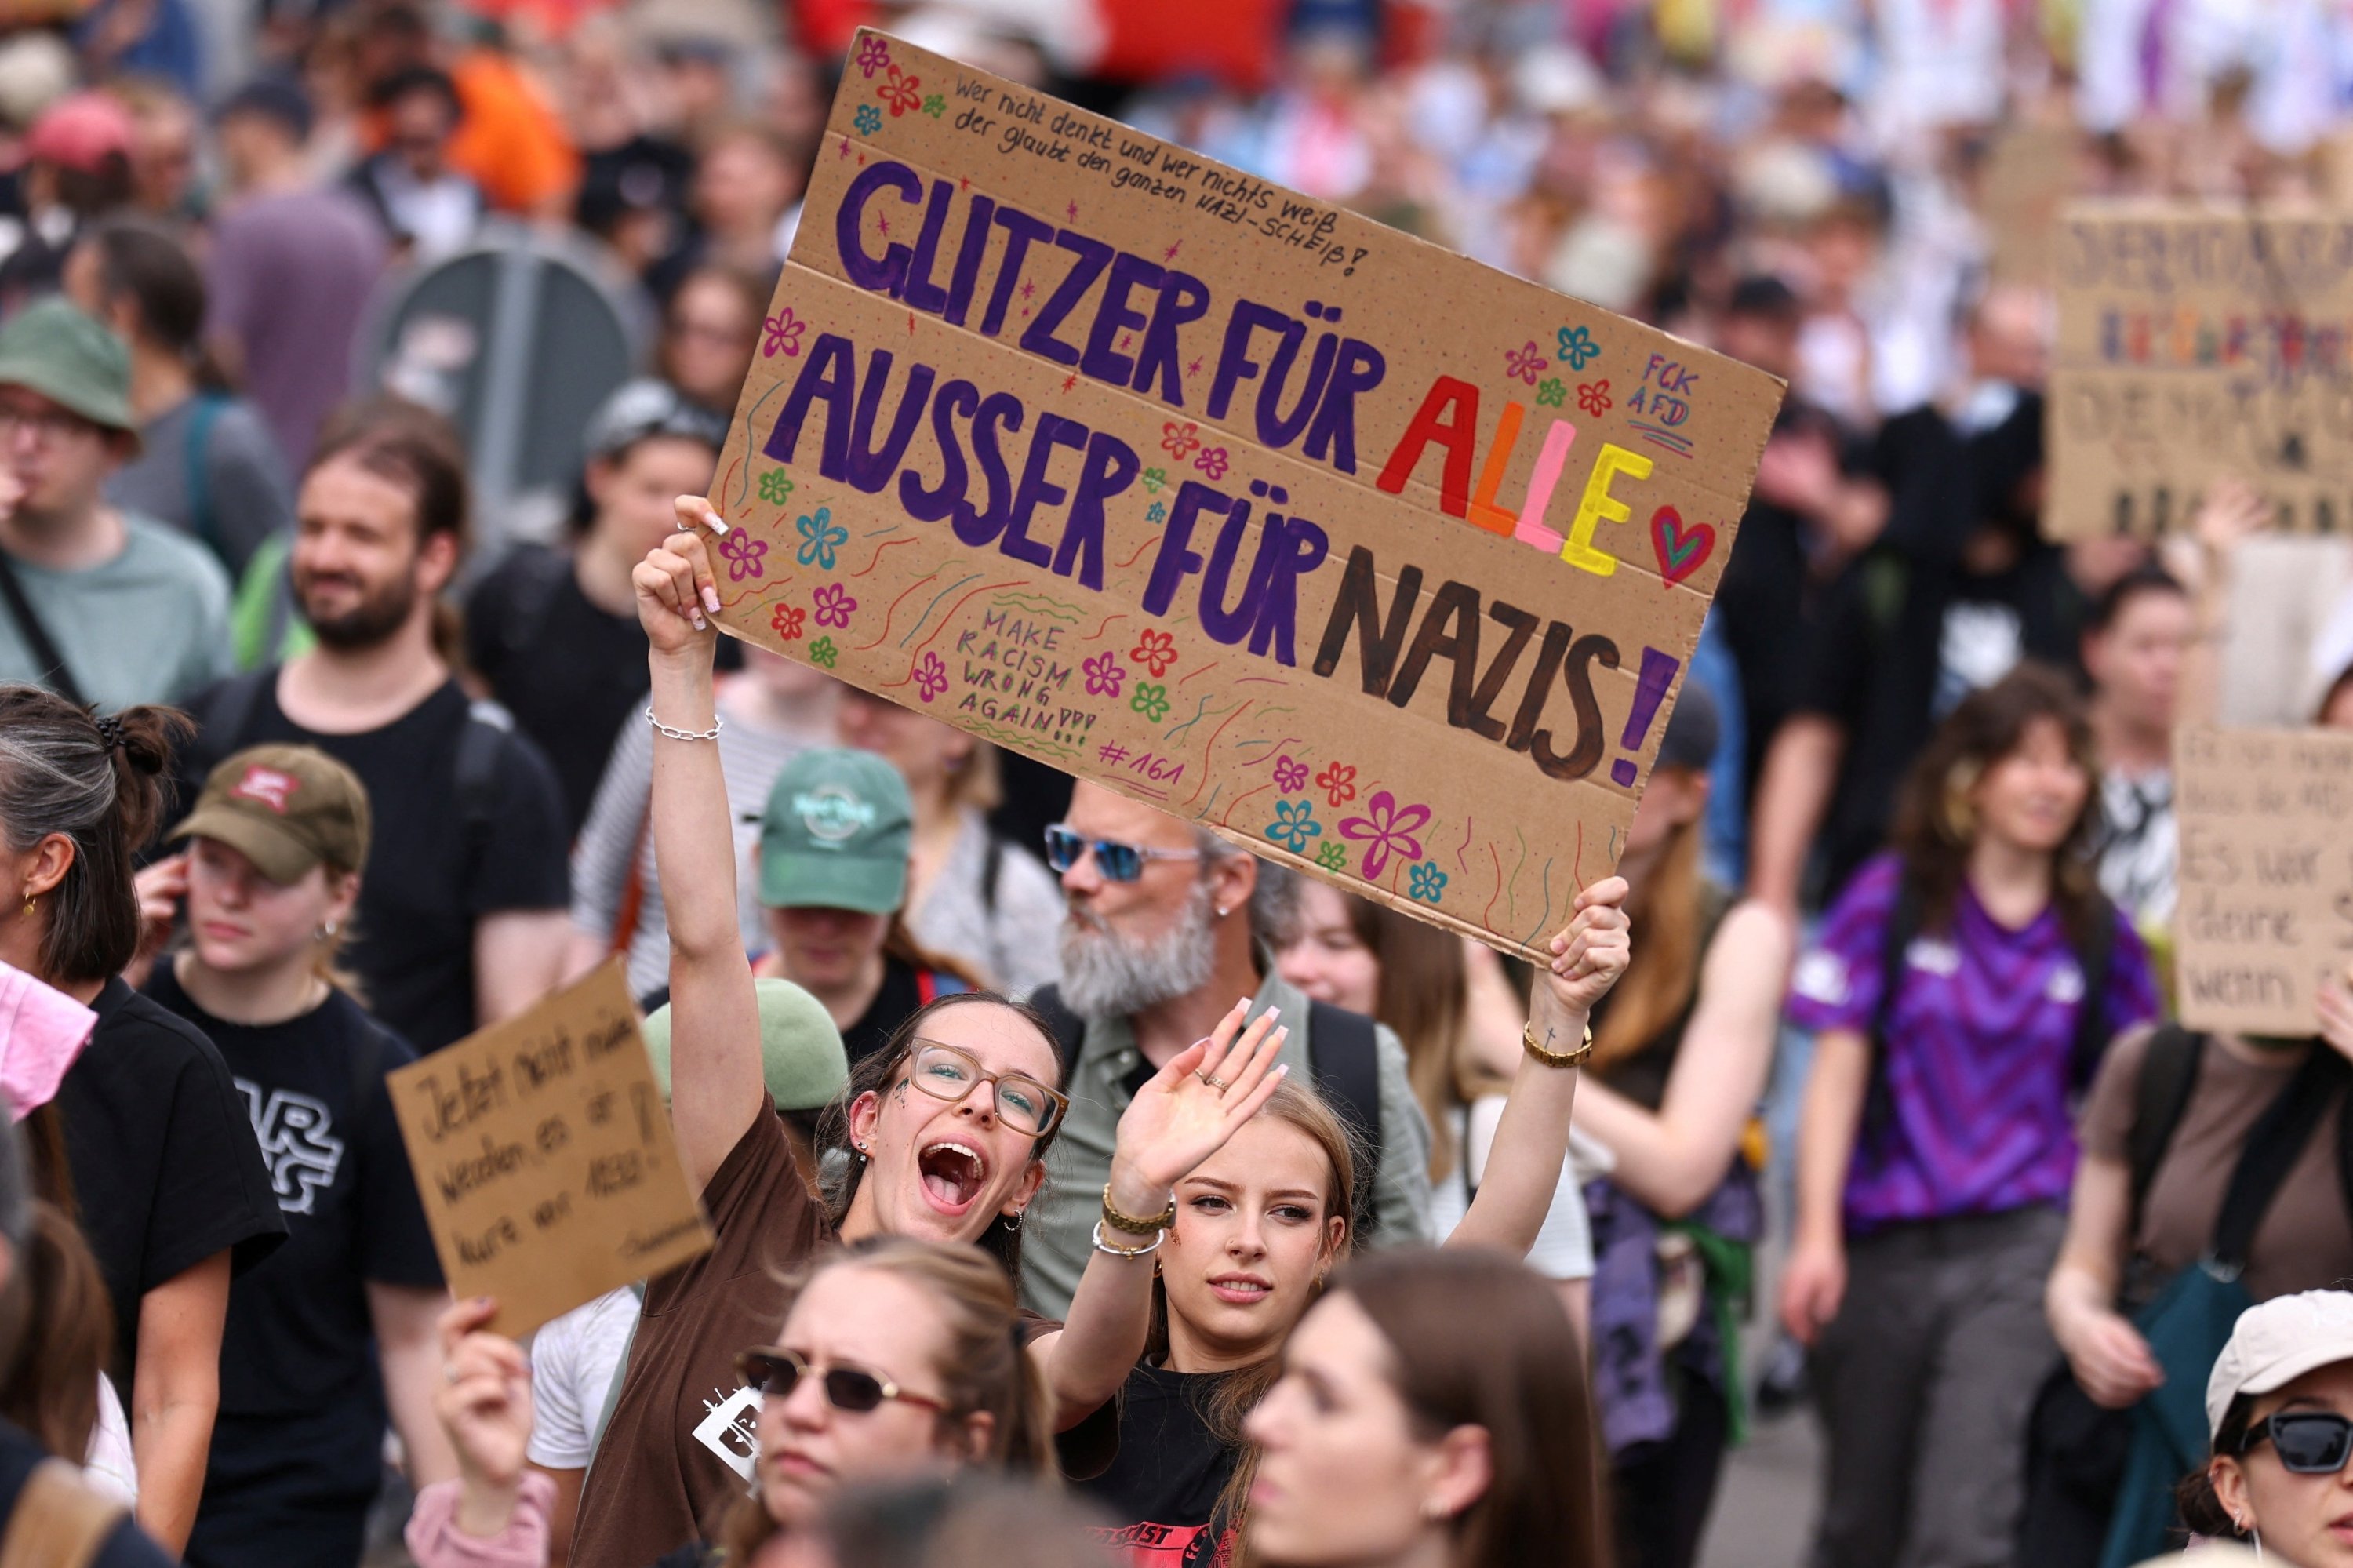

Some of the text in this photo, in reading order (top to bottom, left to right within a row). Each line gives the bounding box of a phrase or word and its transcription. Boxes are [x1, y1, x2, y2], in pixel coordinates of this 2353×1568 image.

[955, 107, 996, 136] der
[998, 126, 1071, 163] glaubt
[1077, 151, 1111, 174] den
[1111, 167, 1187, 203] ganzen
[998, 93, 1045, 124] nicht
[1050, 112, 1112, 149] denkt
[1120, 140, 1160, 166] und
[1202, 169, 1274, 209] nichts
[1280, 198, 1337, 235] weiß
[835, 161, 1653, 577] GLITZER FÜR ALLE
[1642, 351, 1700, 396] FCK
[1627, 386, 1689, 427] AFD
[762, 332, 1680, 788] AUSSER FÜR NAZIS!
[957, 628, 1072, 690] RACISM
[982, 609, 1064, 651] MAKE
[964, 660, 1051, 707] WRONG
[1098, 739, 1185, 784] #161
[415, 1054, 504, 1144] Jetzt
